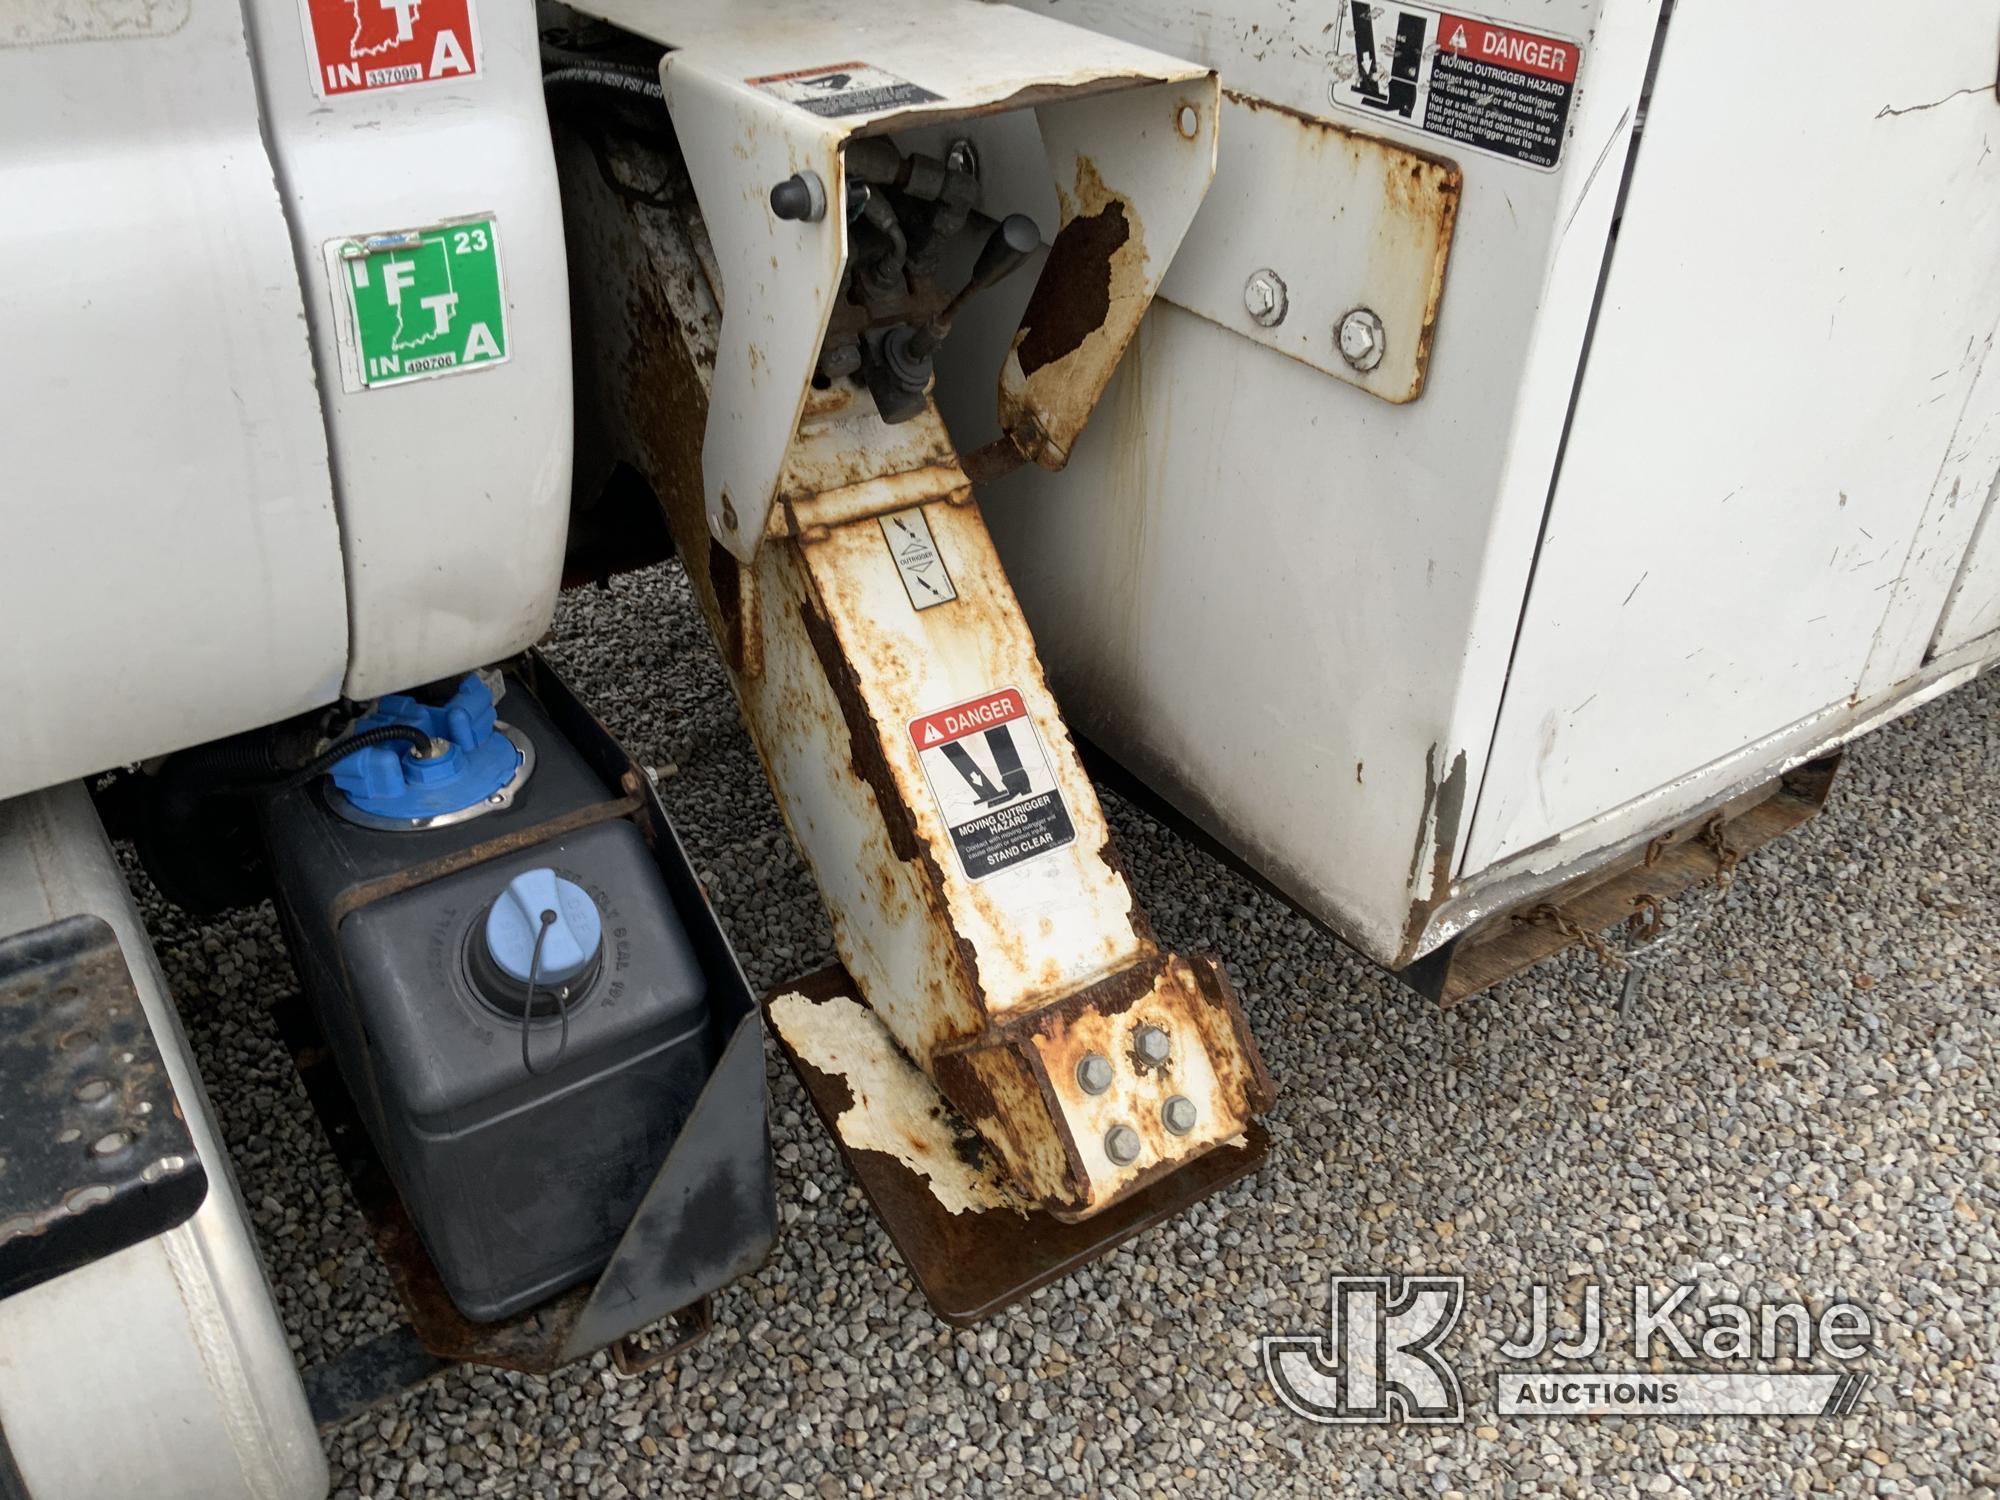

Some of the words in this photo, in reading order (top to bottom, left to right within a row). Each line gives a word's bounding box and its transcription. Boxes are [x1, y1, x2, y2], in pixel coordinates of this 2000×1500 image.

[428, 29, 472, 78] A
[1483, 31, 1567, 72] DANGER
[326, 62, 362, 89] IN
[1433, 69, 1462, 85] Contact
[1464, 78, 1480, 89] with
[1488, 86, 1517, 101] moving
[1518, 93, 1557, 110] outrigger
[1440, 54, 1473, 73] MOVING
[1475, 64, 1526, 86] OUTRIGGER
[1527, 78, 1565, 96] HAZARD
[1431, 92, 1444, 103] You
[1445, 97, 1454, 106] or
[1461, 101, 1485, 116] signal
[1485, 109, 1513, 125] person
[1514, 116, 1534, 129] must
[1535, 123, 1550, 134] see
[1432, 81, 1445, 90] will
[1446, 85, 1469, 96] cause
[1492, 97, 1502, 106] or
[1503, 99, 1533, 114] serious
[1534, 106, 1560, 122] injury.
[1425, 121, 1453, 135] contact
[1454, 129, 1475, 142] point.
[1427, 111, 1445, 123] clear
[1446, 116, 1455, 126] of
[1455, 118, 1468, 129] the
[1468, 124, 1504, 141] outrigger
[1505, 133, 1521, 146] and
[1522, 136, 1532, 149] its
[1429, 102, 1442, 113] that
[1443, 106, 1479, 123] personnel
[1479, 117, 1493, 128] and
[1494, 120, 1542, 140] obstructions
[1543, 136, 1557, 146] are
[453, 229, 488, 255] 23
[369, 354, 400, 377] IN
[944, 698, 1015, 734] DANGER
[958, 816, 997, 837] MOVING
[997, 794, 1051, 821] OUTRIGGER
[989, 814, 1028, 835] HAZARD
[965, 839, 988, 853] Contact
[1000, 828, 1023, 842] moving
[987, 846, 1020, 866] STAND
[1020, 833, 1054, 852] CLEAR
